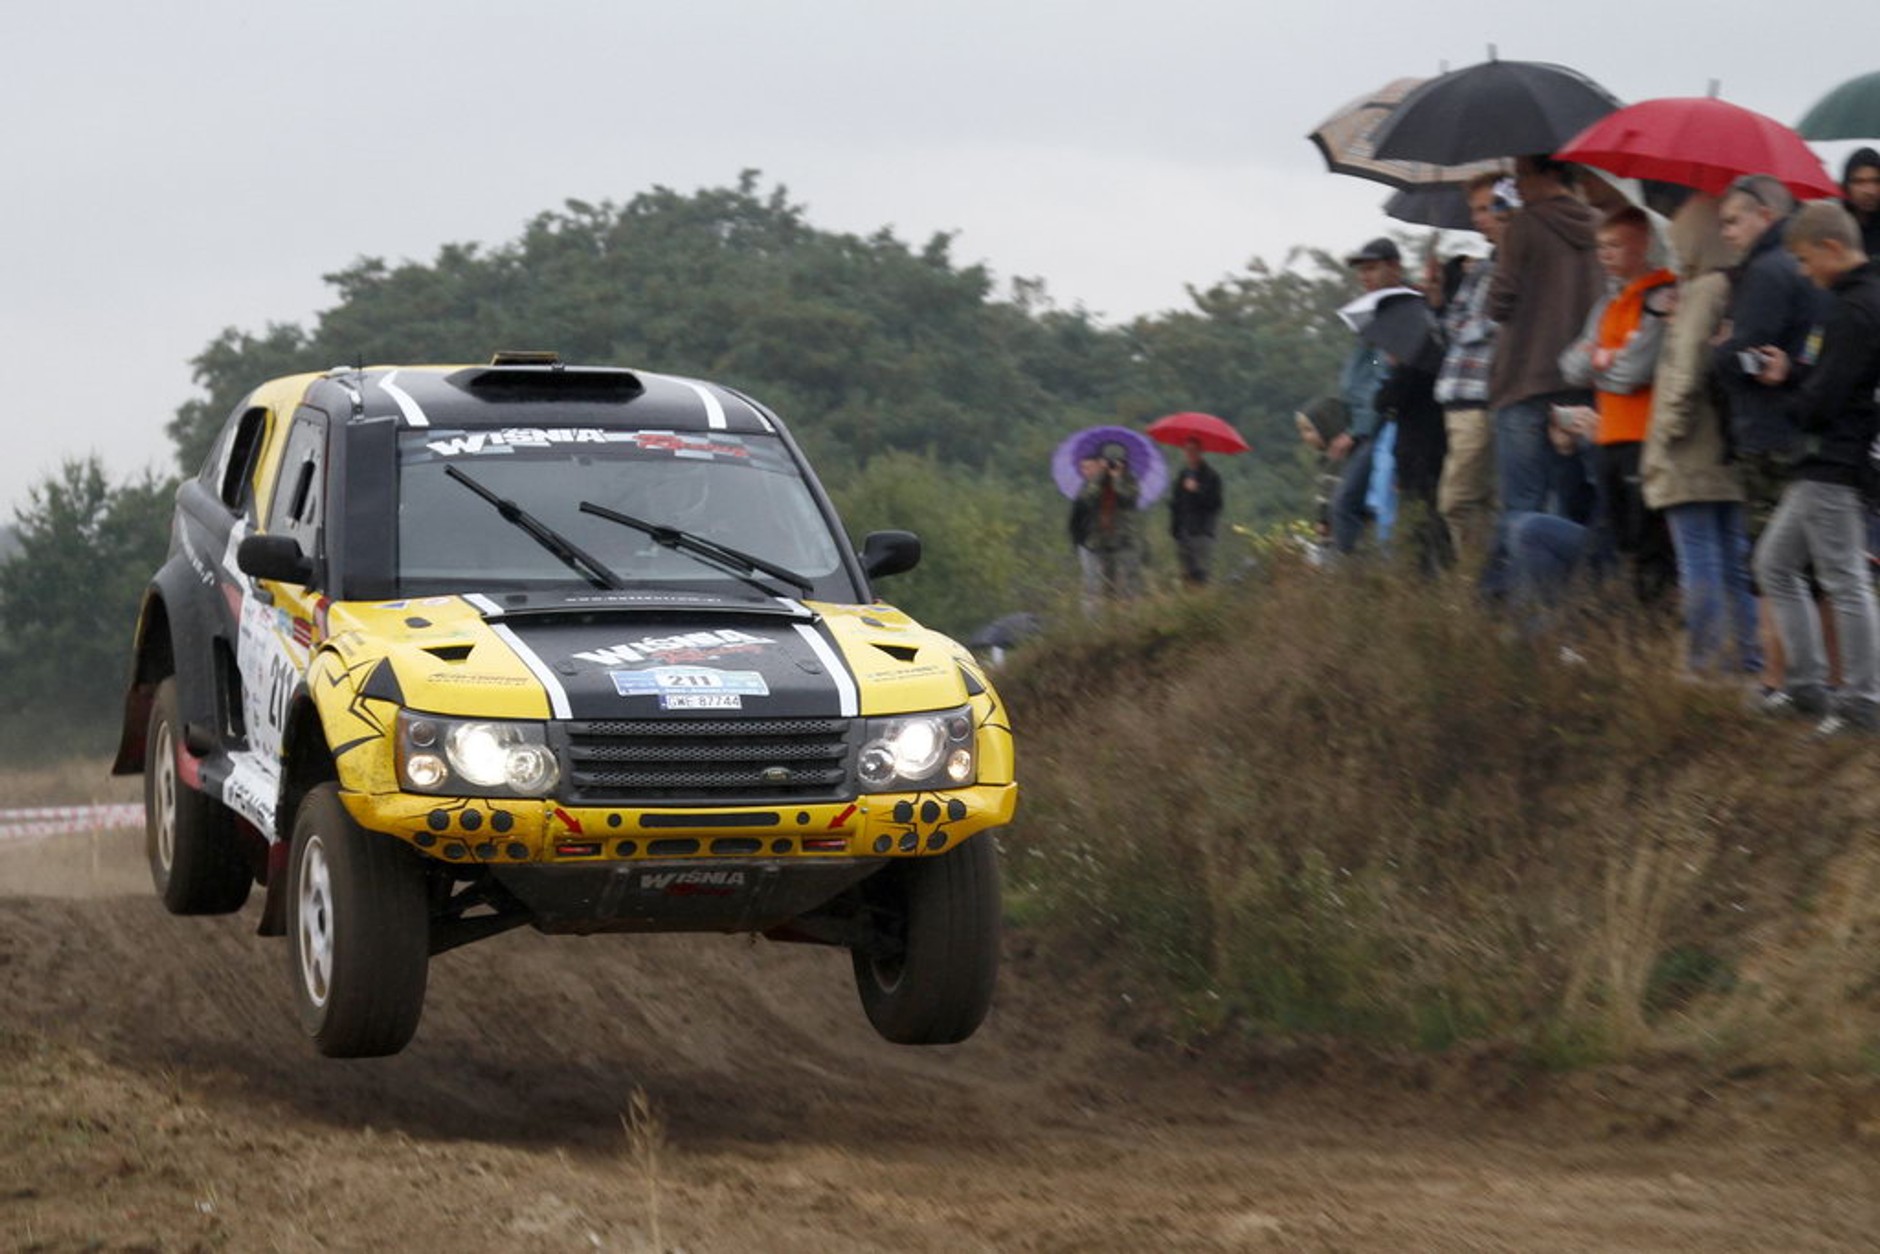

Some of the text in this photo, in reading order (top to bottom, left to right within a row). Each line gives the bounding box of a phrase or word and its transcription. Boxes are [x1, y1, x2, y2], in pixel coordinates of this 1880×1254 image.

[426, 428, 607, 456] WIŚNIA
[268, 653, 294, 733] 211
[668, 674, 713, 687] 211
